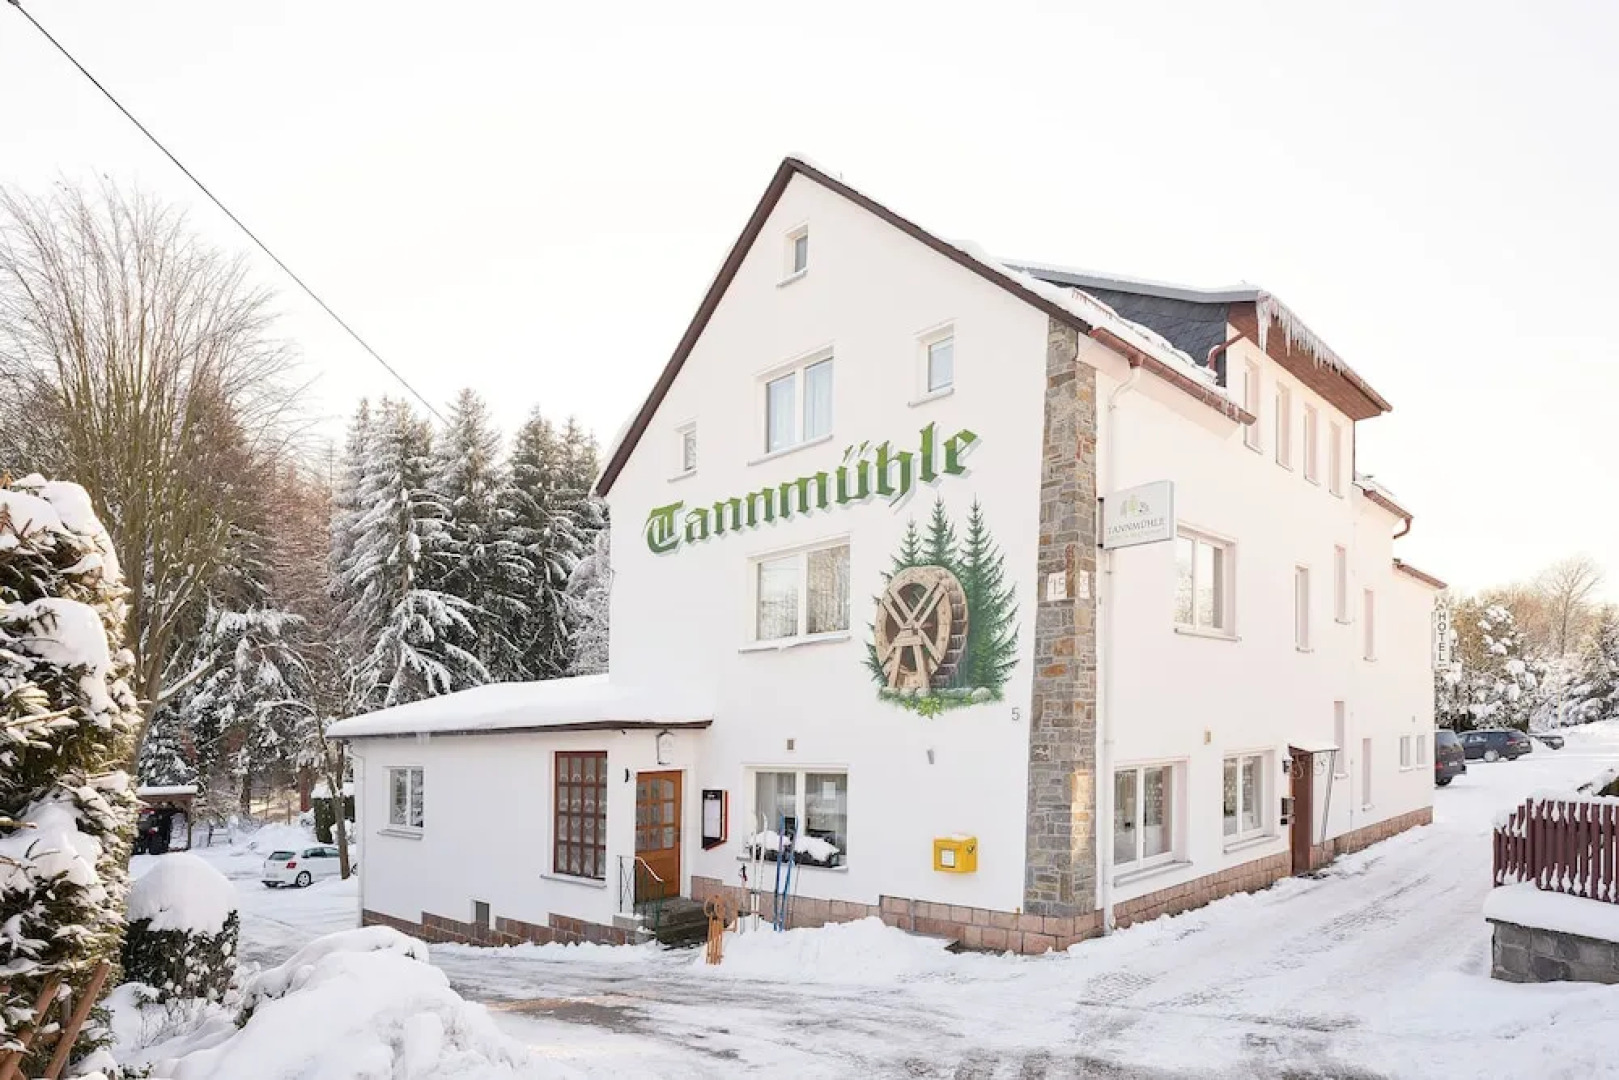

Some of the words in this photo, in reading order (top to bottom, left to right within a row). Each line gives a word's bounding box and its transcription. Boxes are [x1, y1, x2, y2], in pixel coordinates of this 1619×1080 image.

[642, 420, 979, 554] Tannmühle
[1437, 611, 1447, 662] HOTEL
[1011, 707, 1021, 721] 5
